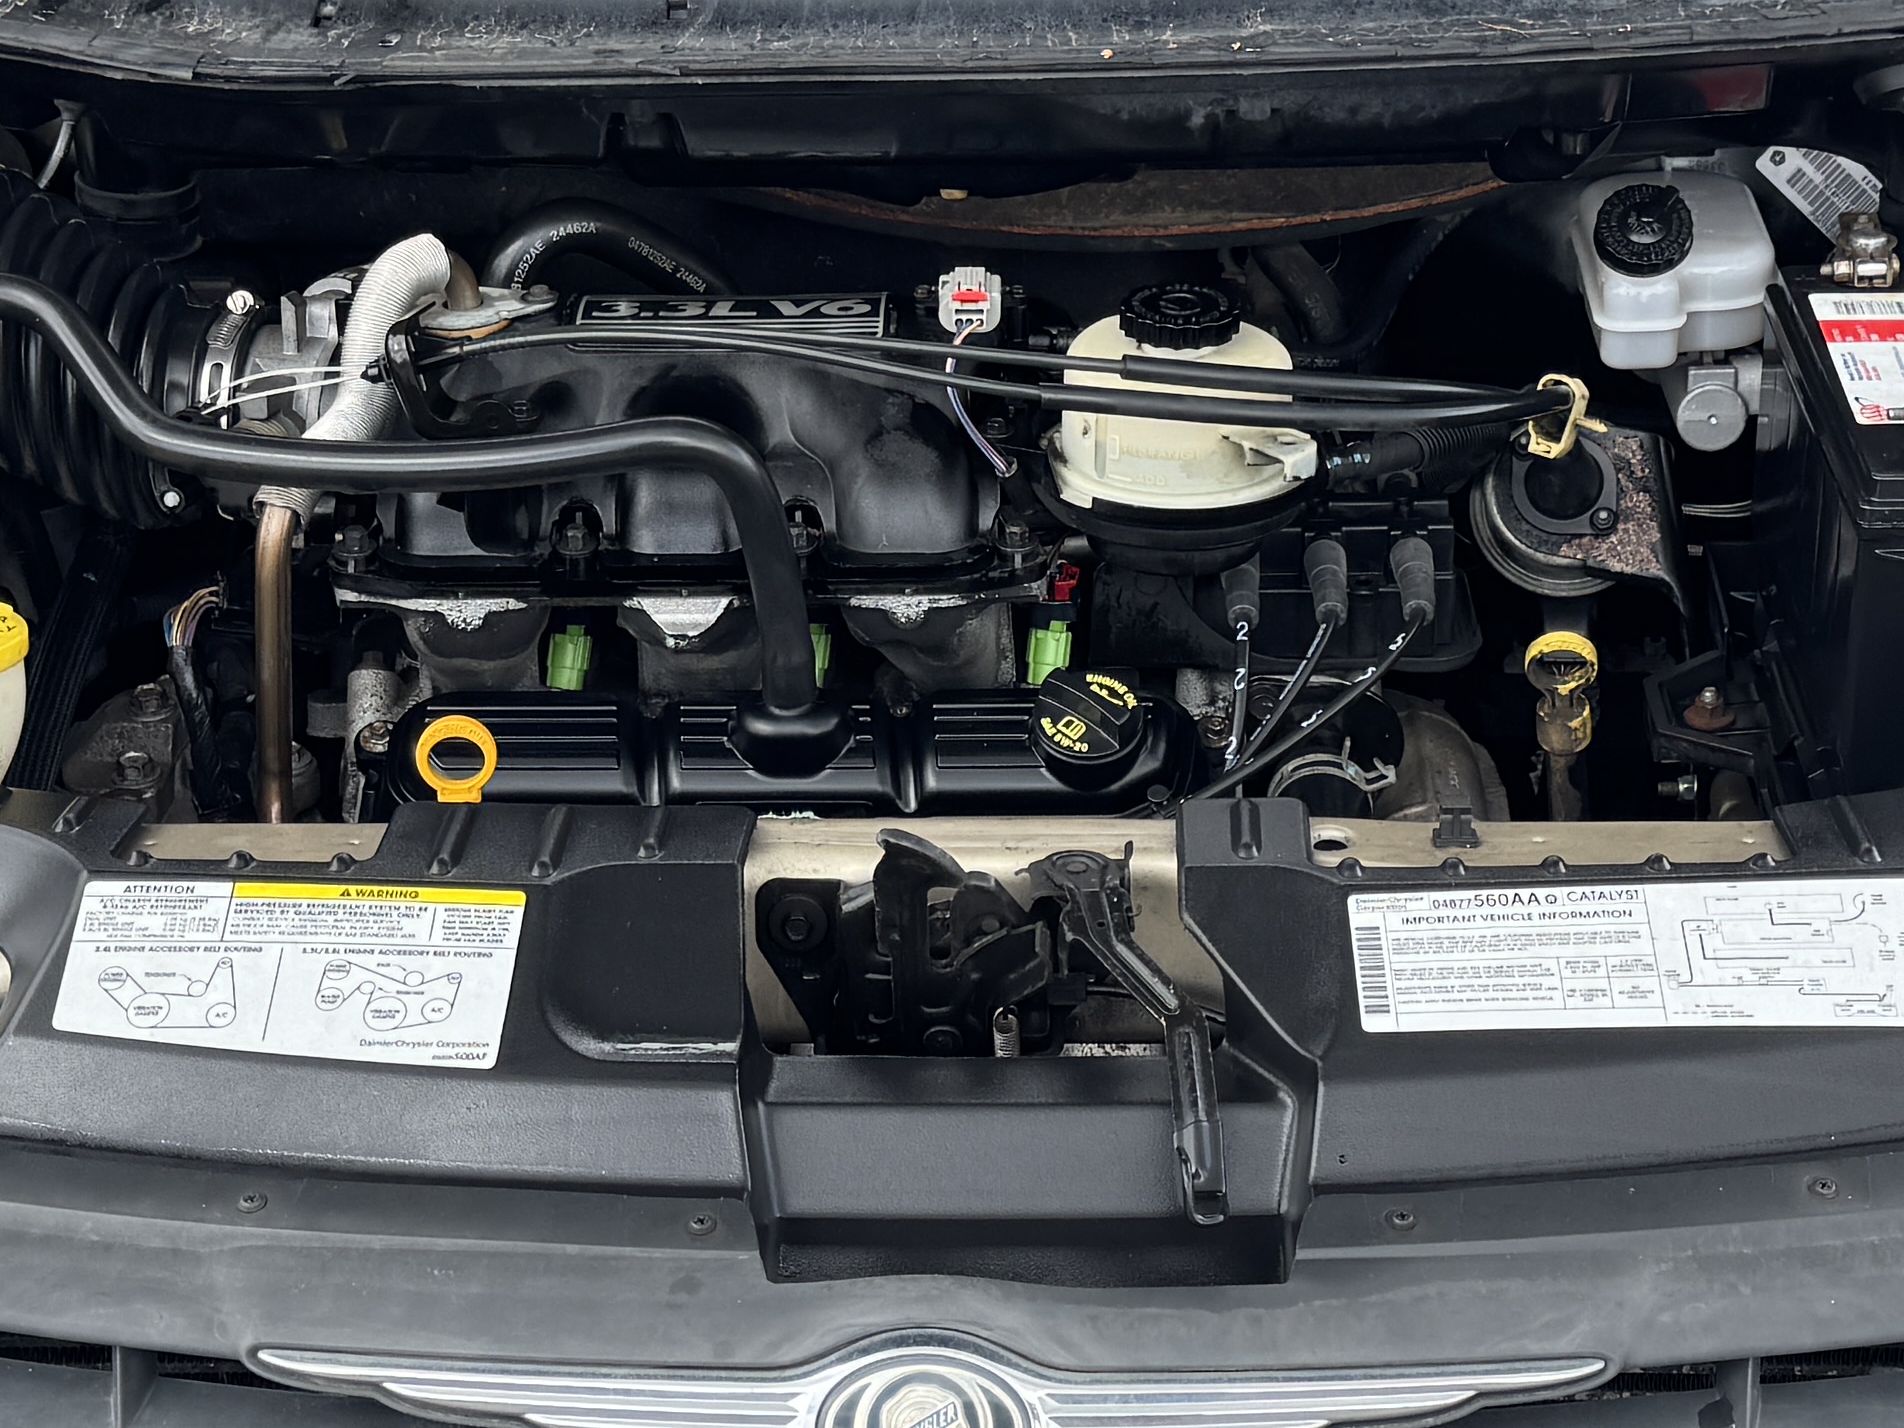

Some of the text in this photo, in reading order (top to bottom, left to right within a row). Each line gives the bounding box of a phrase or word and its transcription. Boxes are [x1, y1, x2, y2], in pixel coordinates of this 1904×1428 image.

[549, 222, 597, 242] 24462A
[591, 298, 872, 317] 3.3L V6
[123, 884, 196, 895] ATTENTION
[354, 888, 420, 900] WARNING
[1566, 889, 1640, 903] CATALYST
[1401, 909, 1634, 925] IMPORTANT VEHICLE INFORMATION
